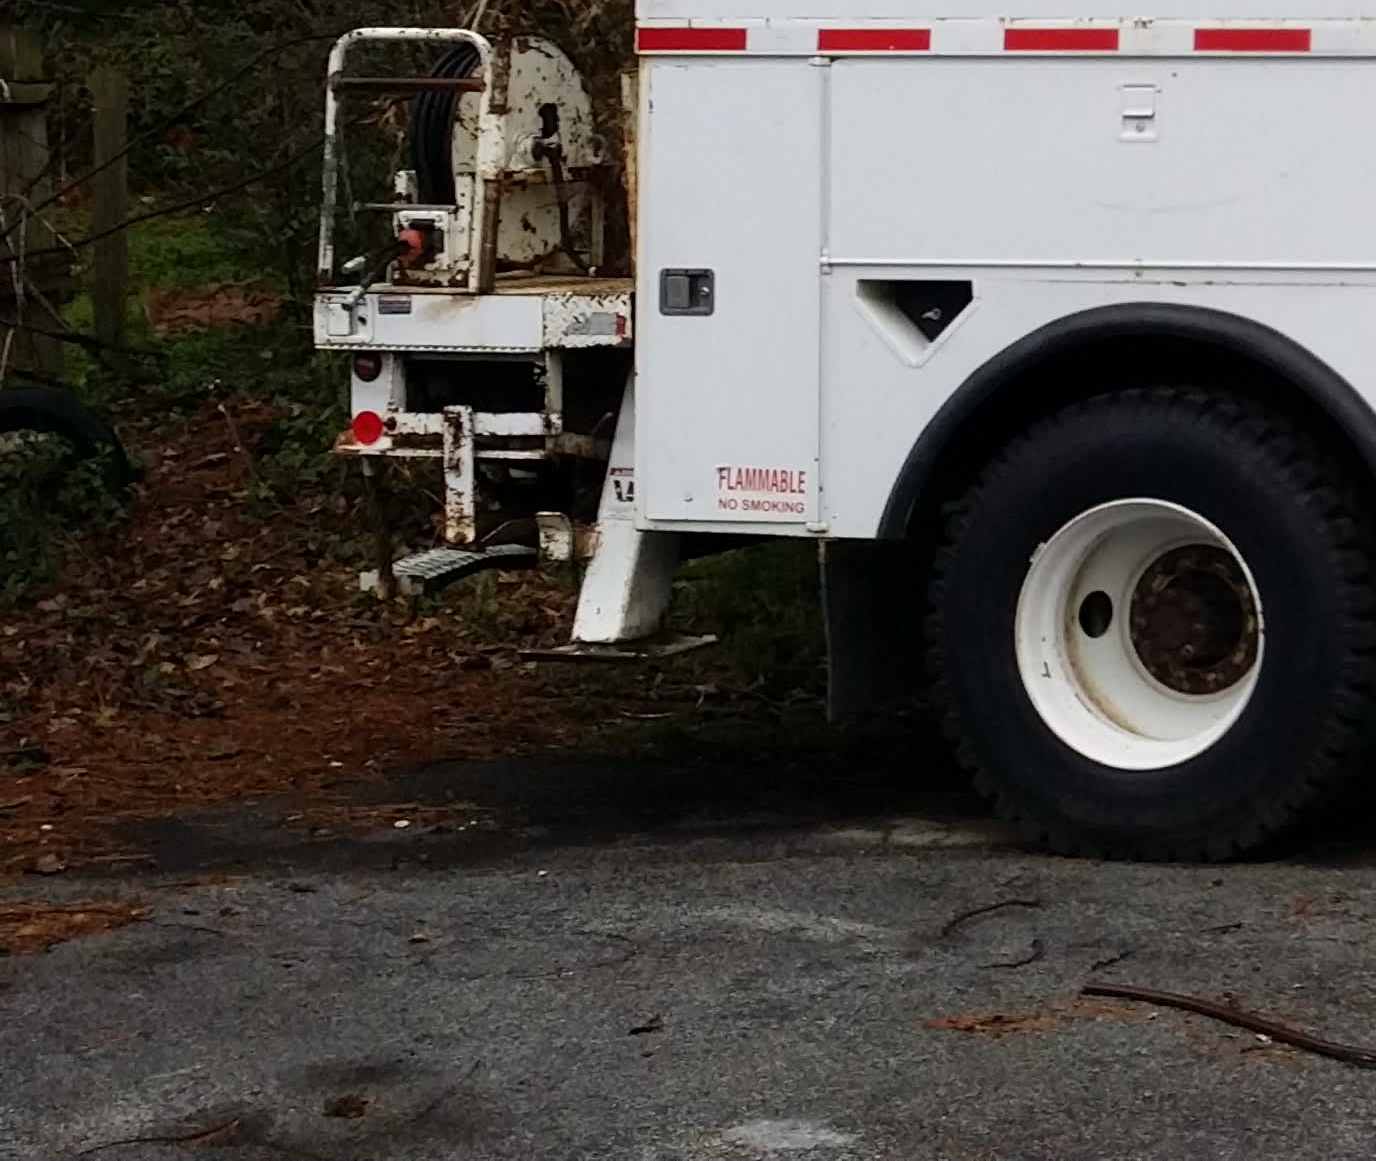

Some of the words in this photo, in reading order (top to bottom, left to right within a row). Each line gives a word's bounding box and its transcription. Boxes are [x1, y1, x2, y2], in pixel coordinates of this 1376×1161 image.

[717, 466, 806, 494] FLAMMABLE
[718, 498, 738, 510] NO
[742, 498, 805, 514] SMOKING
